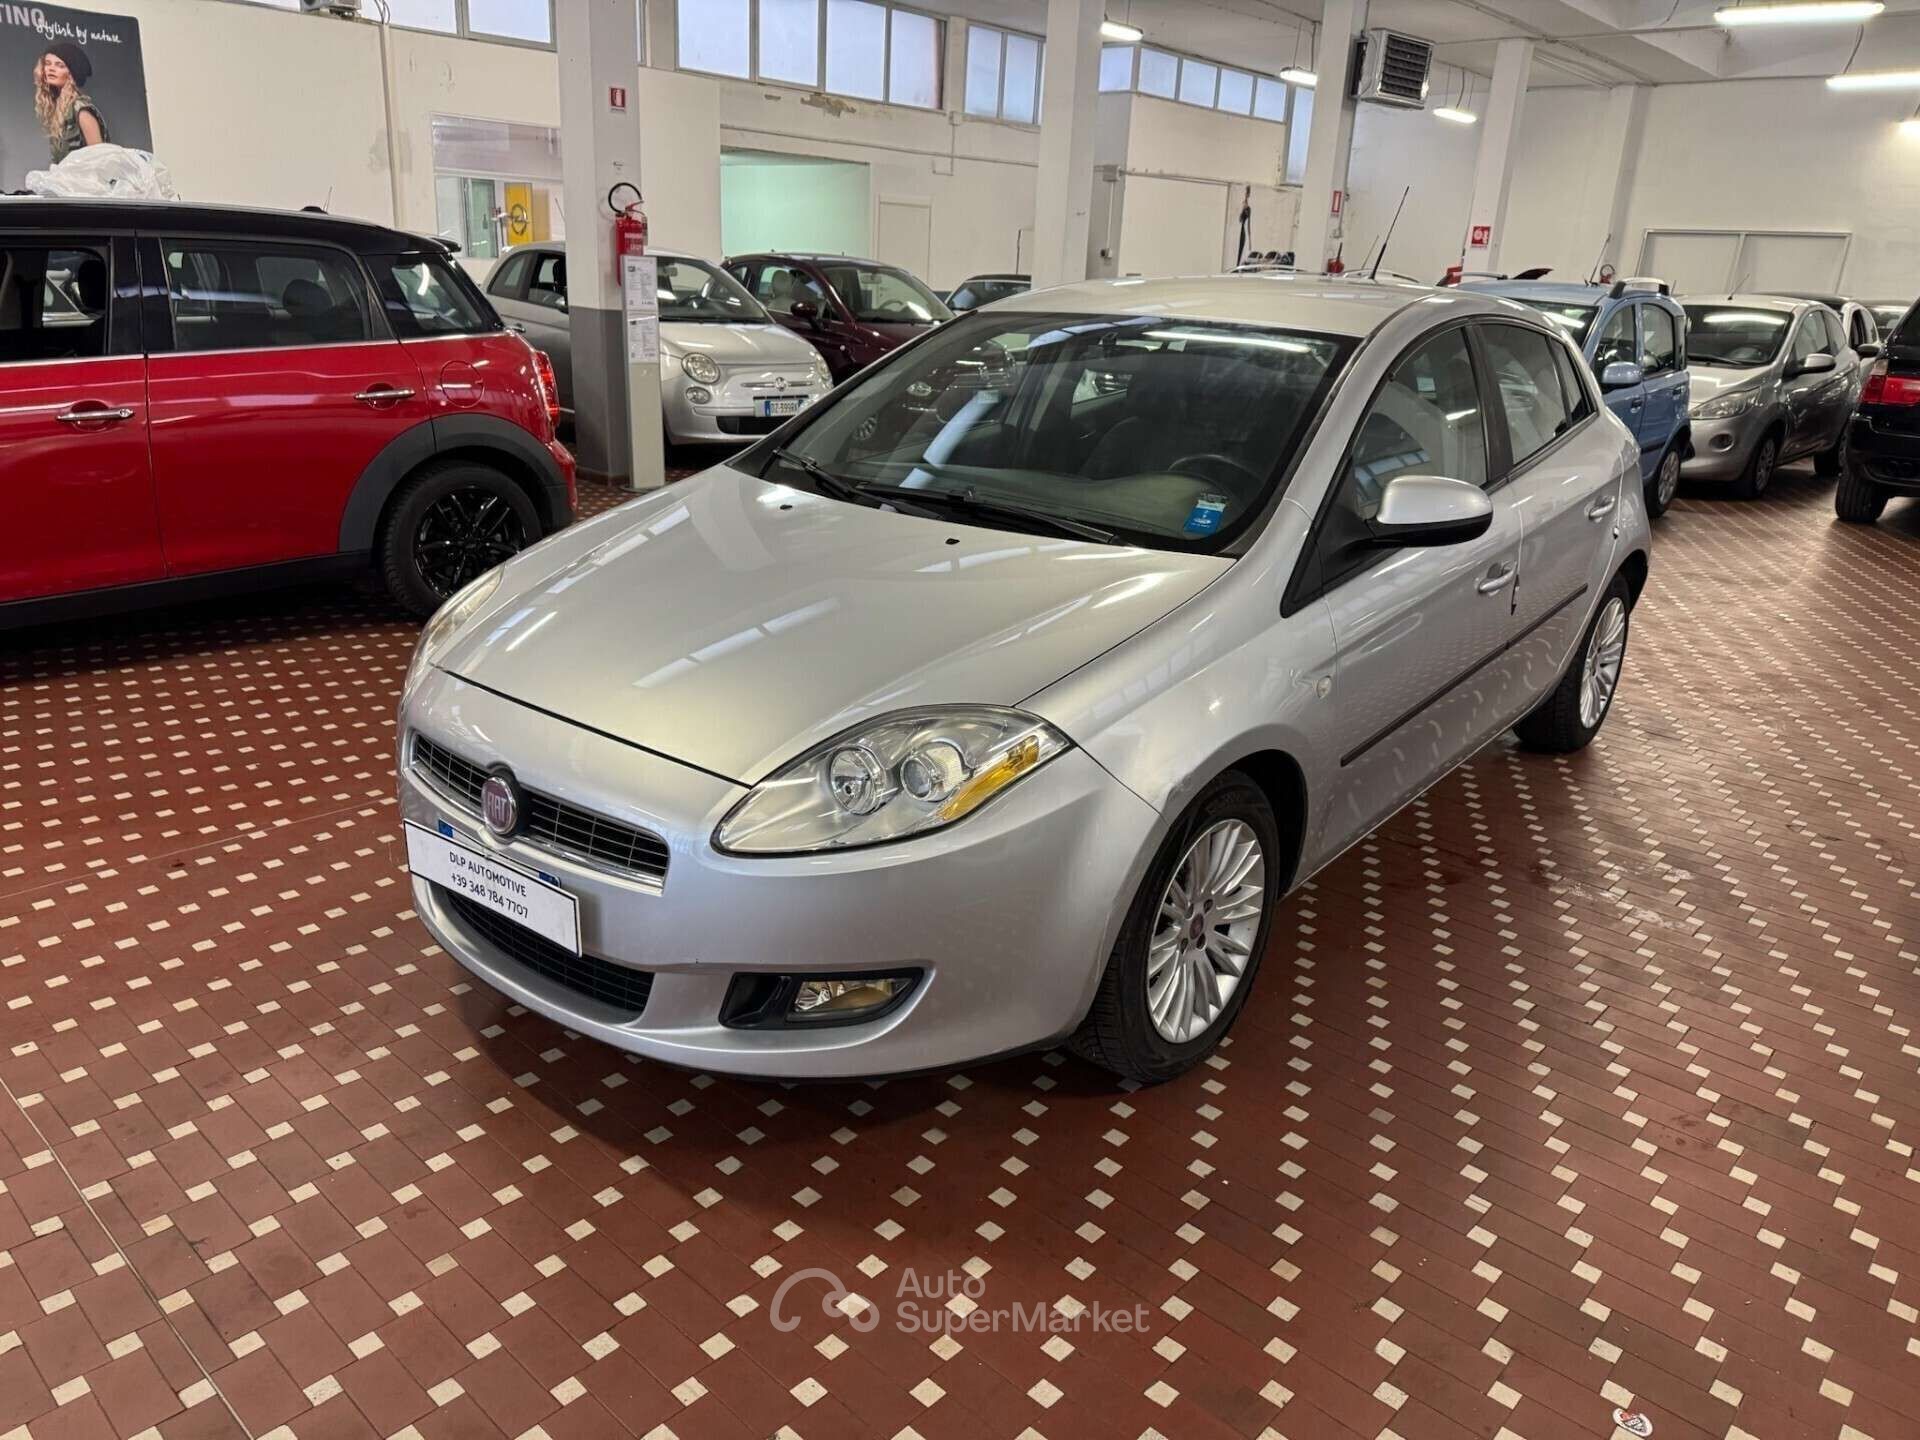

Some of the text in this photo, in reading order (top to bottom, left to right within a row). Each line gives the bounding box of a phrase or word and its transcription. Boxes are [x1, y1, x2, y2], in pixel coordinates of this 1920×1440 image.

[76, 25, 88, 45] by
[485, 790, 508, 822] FIAT
[449, 851, 527, 897] DLP AUTOMOTIVE
[451, 872, 529, 919] +39 348 784 7707
